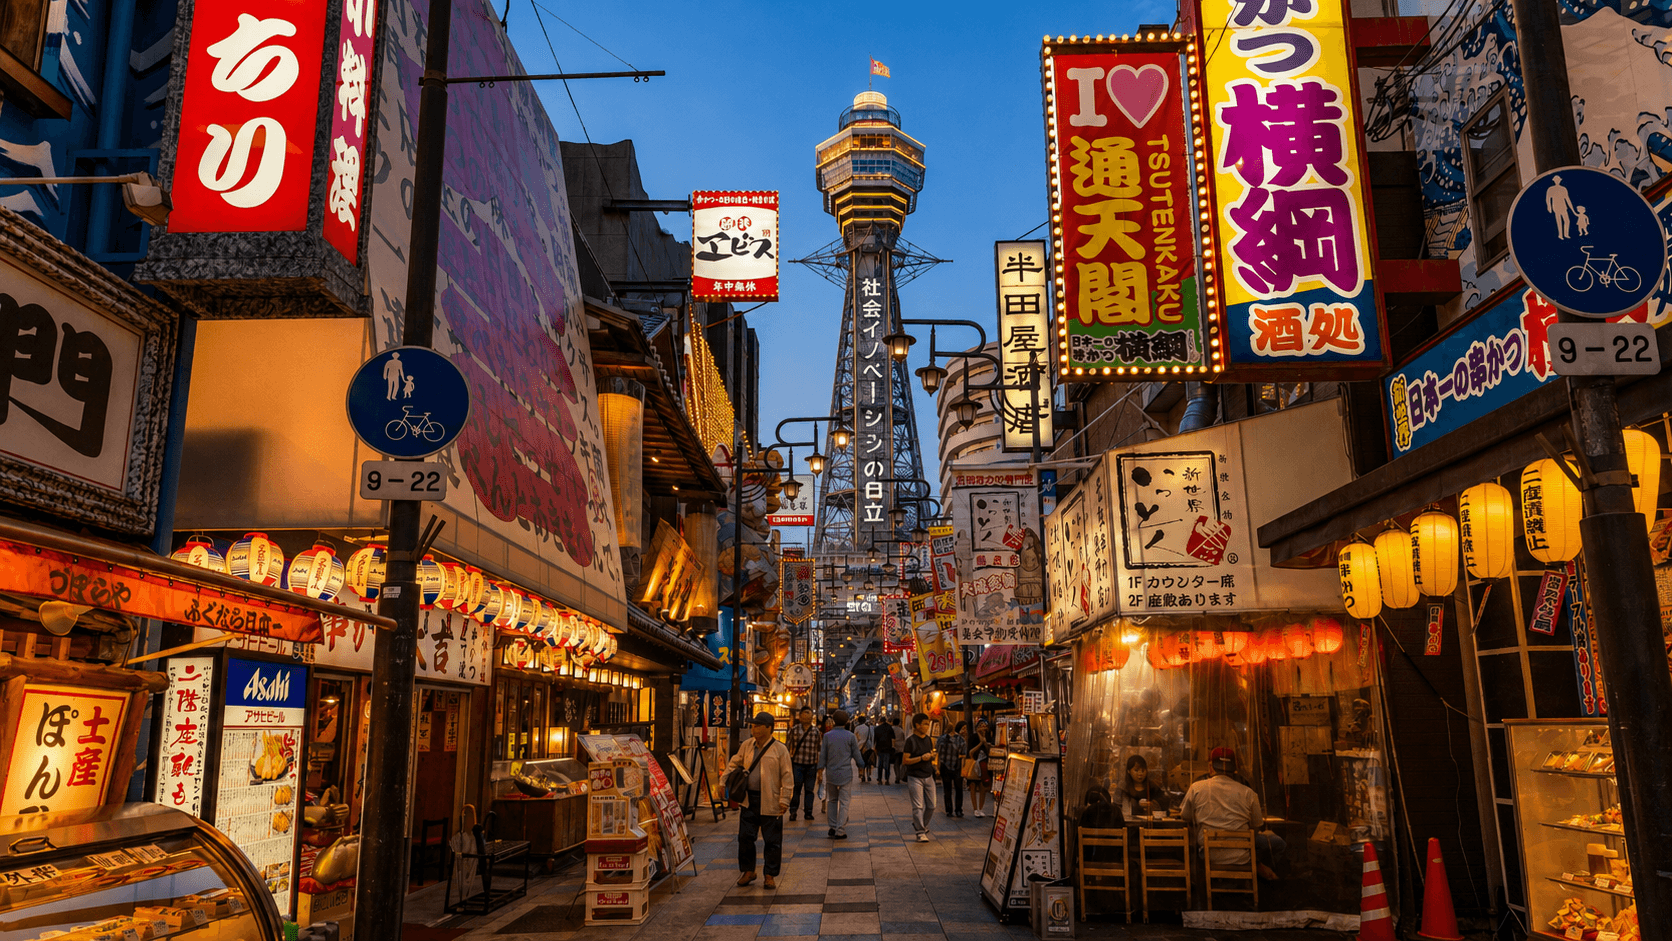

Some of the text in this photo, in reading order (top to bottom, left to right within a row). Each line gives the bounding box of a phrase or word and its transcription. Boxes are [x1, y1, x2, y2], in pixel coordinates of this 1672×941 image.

[1067, 66, 1108, 127] I
[1218, 79, 1361, 296] 横綱
[696, 231, 775, 262] エビス
[1068, 135, 1152, 327] 通天閣
[1146, 134, 1182, 324] TSUTENKAKU
[1252, 306, 1361, 353] 酒処
[1406, 329, 1525, 432] 日本一の串かつ
[1128, 573, 1236, 589] 1F カウンター席
[1128, 592, 1237, 608] 2F 座敷あります
[243, 667, 291, 702] Asahi
[244, 709, 286, 724] アサヒビール
[66, 705, 111, 788] 土産
